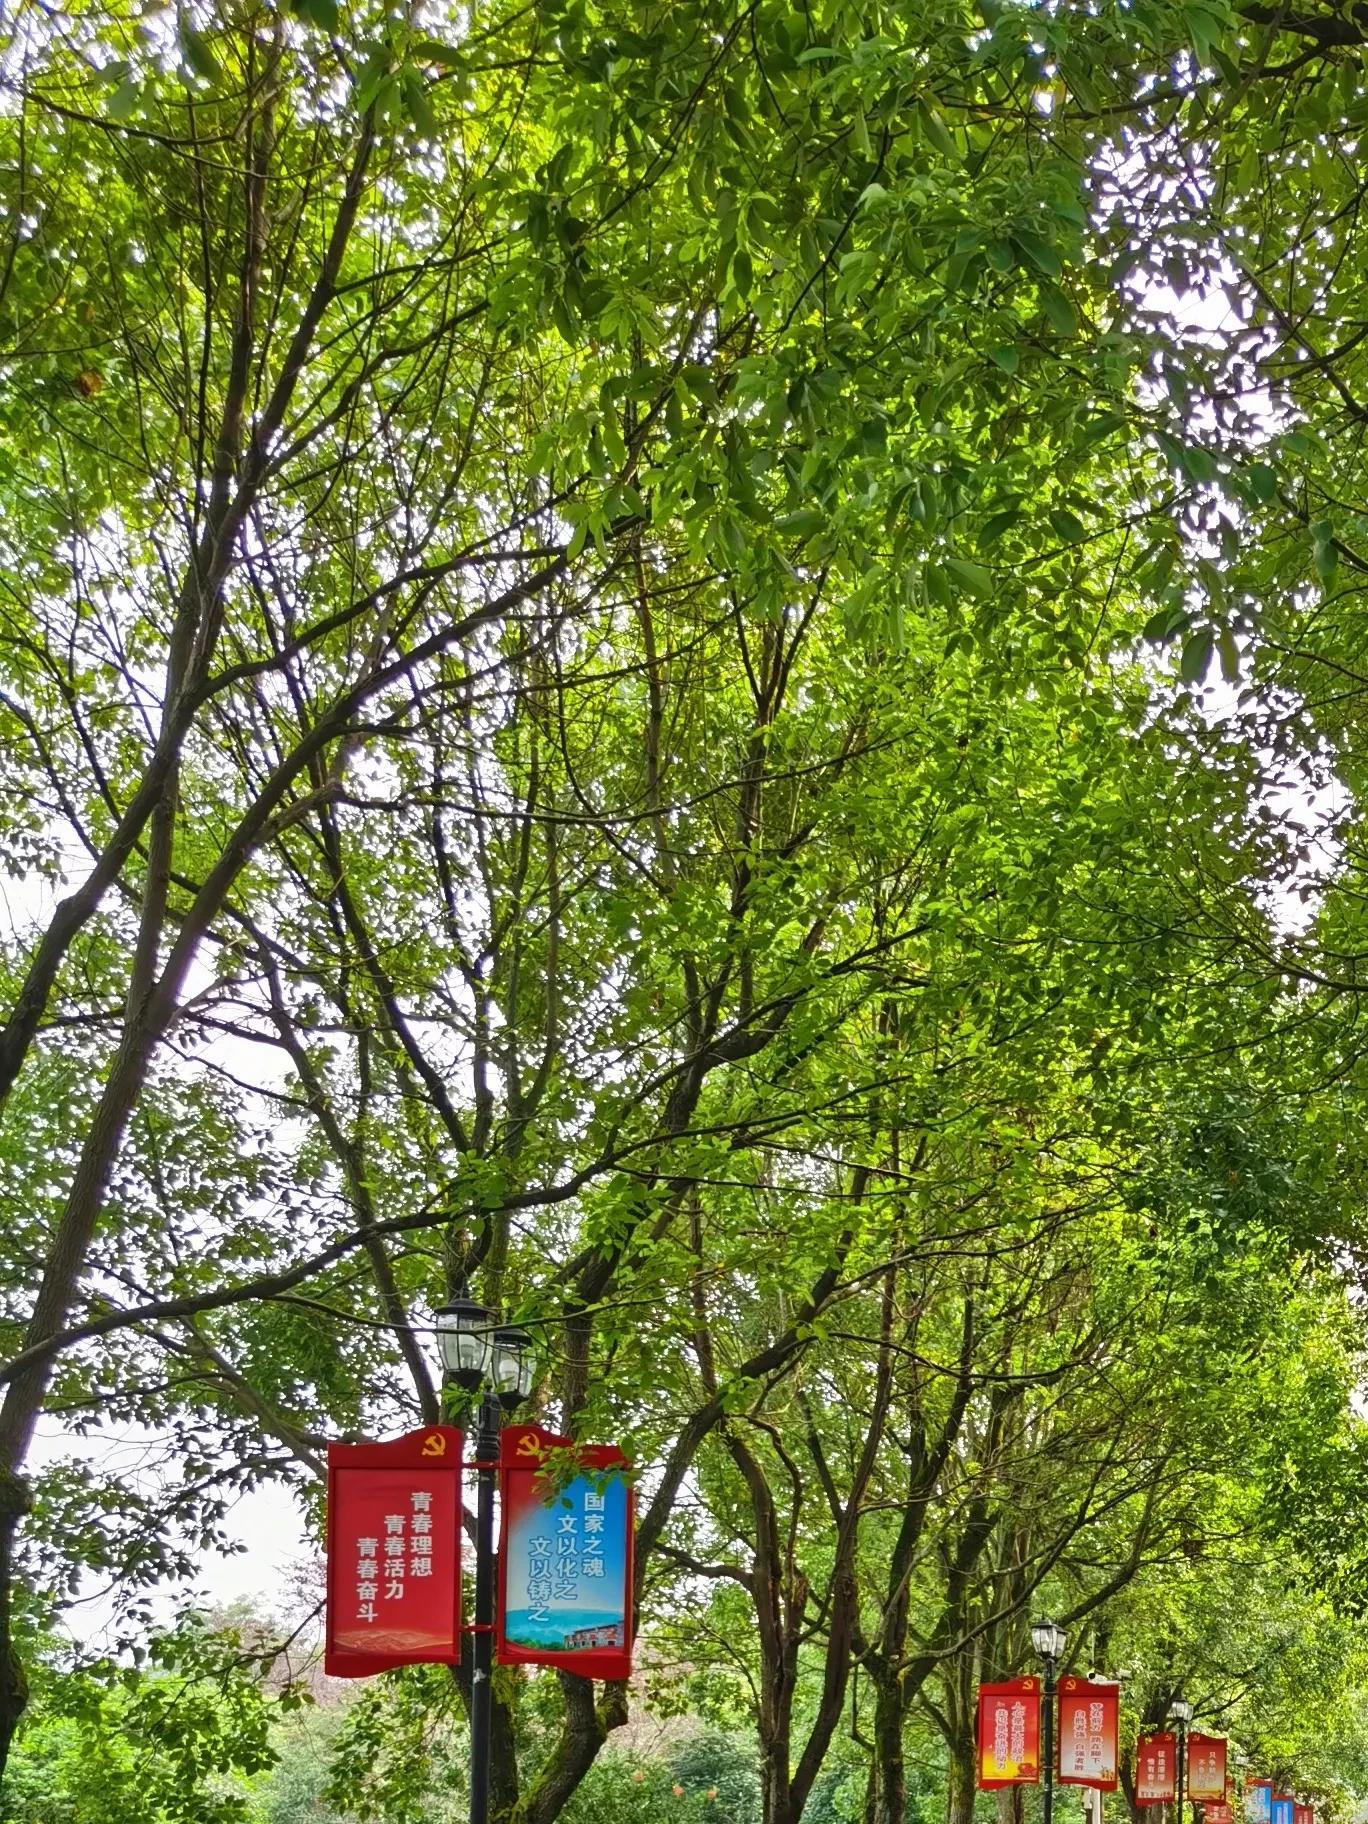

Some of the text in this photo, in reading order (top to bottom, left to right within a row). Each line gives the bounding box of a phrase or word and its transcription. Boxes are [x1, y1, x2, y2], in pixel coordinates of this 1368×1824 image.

[384, 1514, 406, 1600] 青春活力
[410, 1491, 433, 1577] 青春理想
[554, 1514, 578, 1600] 文以化之
[582, 1492, 605, 1577] 国家之魂
[356, 1537, 378, 1623] 青春奋斗
[527, 1537, 550, 1622] 文以铸之
